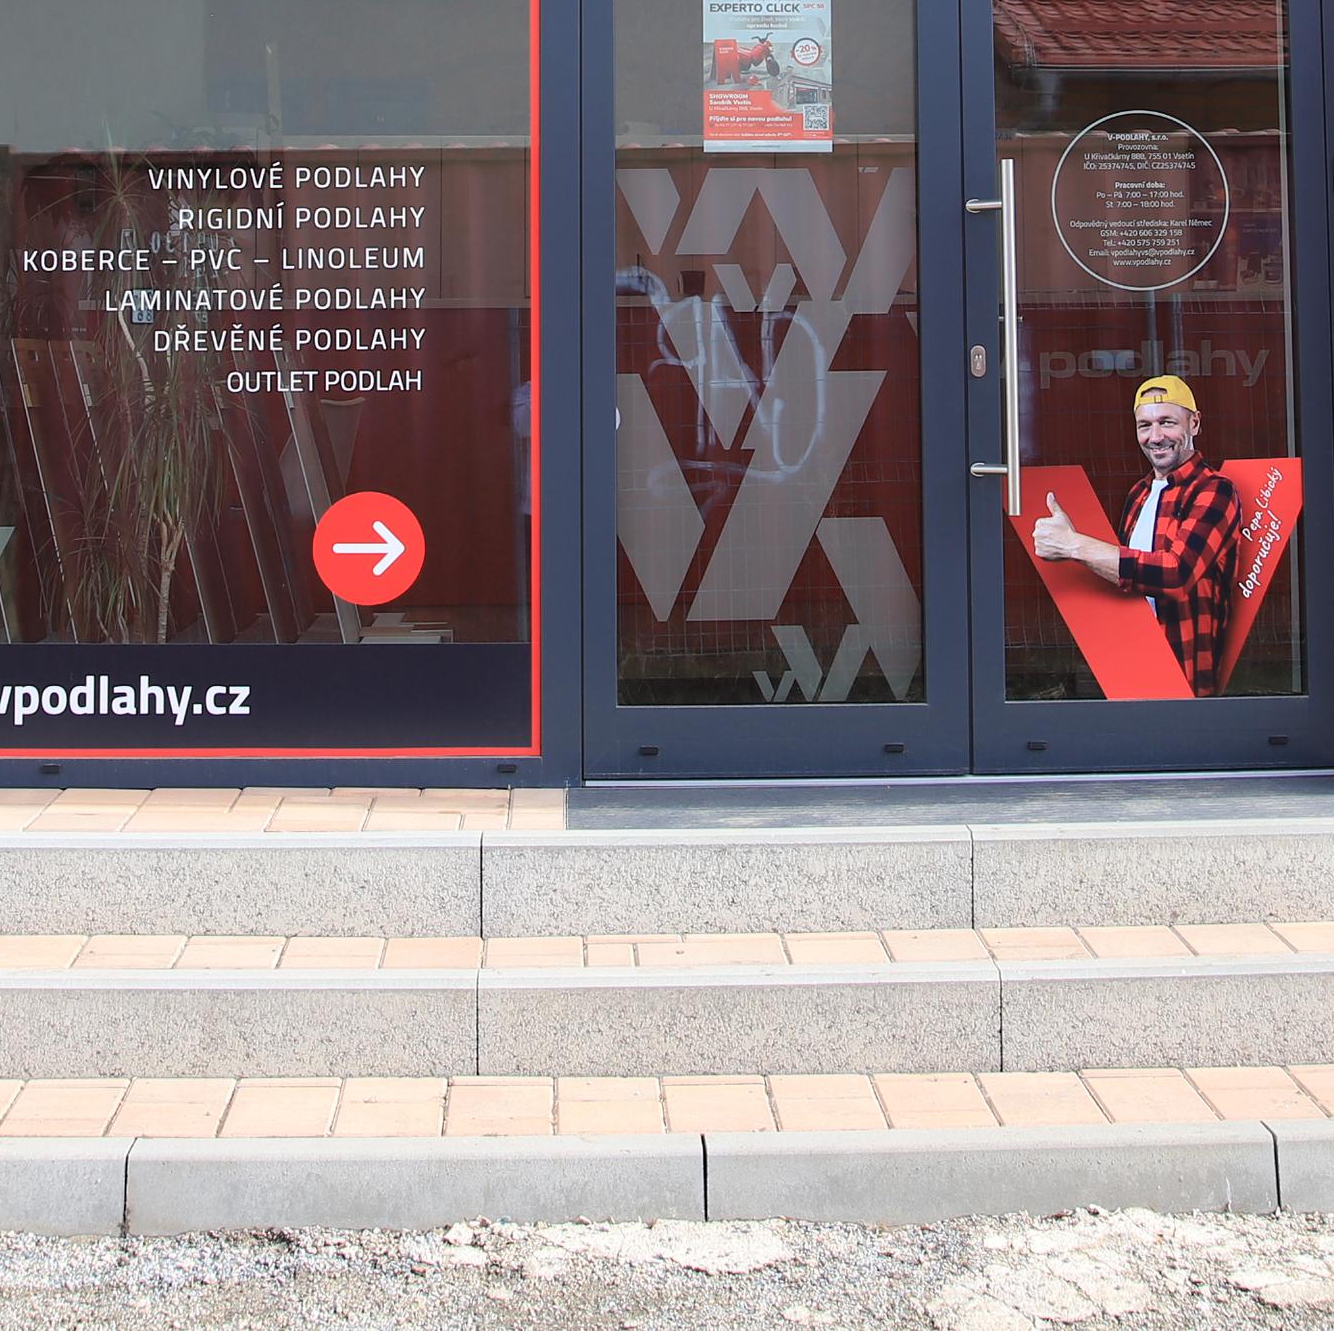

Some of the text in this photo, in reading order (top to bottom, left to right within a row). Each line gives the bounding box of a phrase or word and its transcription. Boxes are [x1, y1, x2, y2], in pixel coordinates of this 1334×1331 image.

[710, 3, 763, 12] EXPERTO
[766, 3, 800, 12] CLICK
[1107, 134, 1150, 142] V-PODLAHY,
[1091, 153, 1130, 161] Křivačkárny
[148, 161, 425, 190] VINYLOVÉ PODLAHY
[179, 201, 425, 230] RIGIDNÍ PODLAHY
[1070, 220, 1108, 228] Odpovědný
[24, 249, 150, 271] KOBERCE
[191, 249, 241, 270] PVC
[283, 247, 423, 269] LINOLEUM
[106, 283, 283, 311] LAMINATOVÉ
[296, 288, 425, 310] PODLAHY
[154, 323, 425, 351] DŘEVĚNÉ PODLAHY
[227, 370, 421, 393] OUTLET PODLAH
[1243, 466, 1283, 542] Pepa Libický
[1238, 510, 1282, 599] doporučuje!
